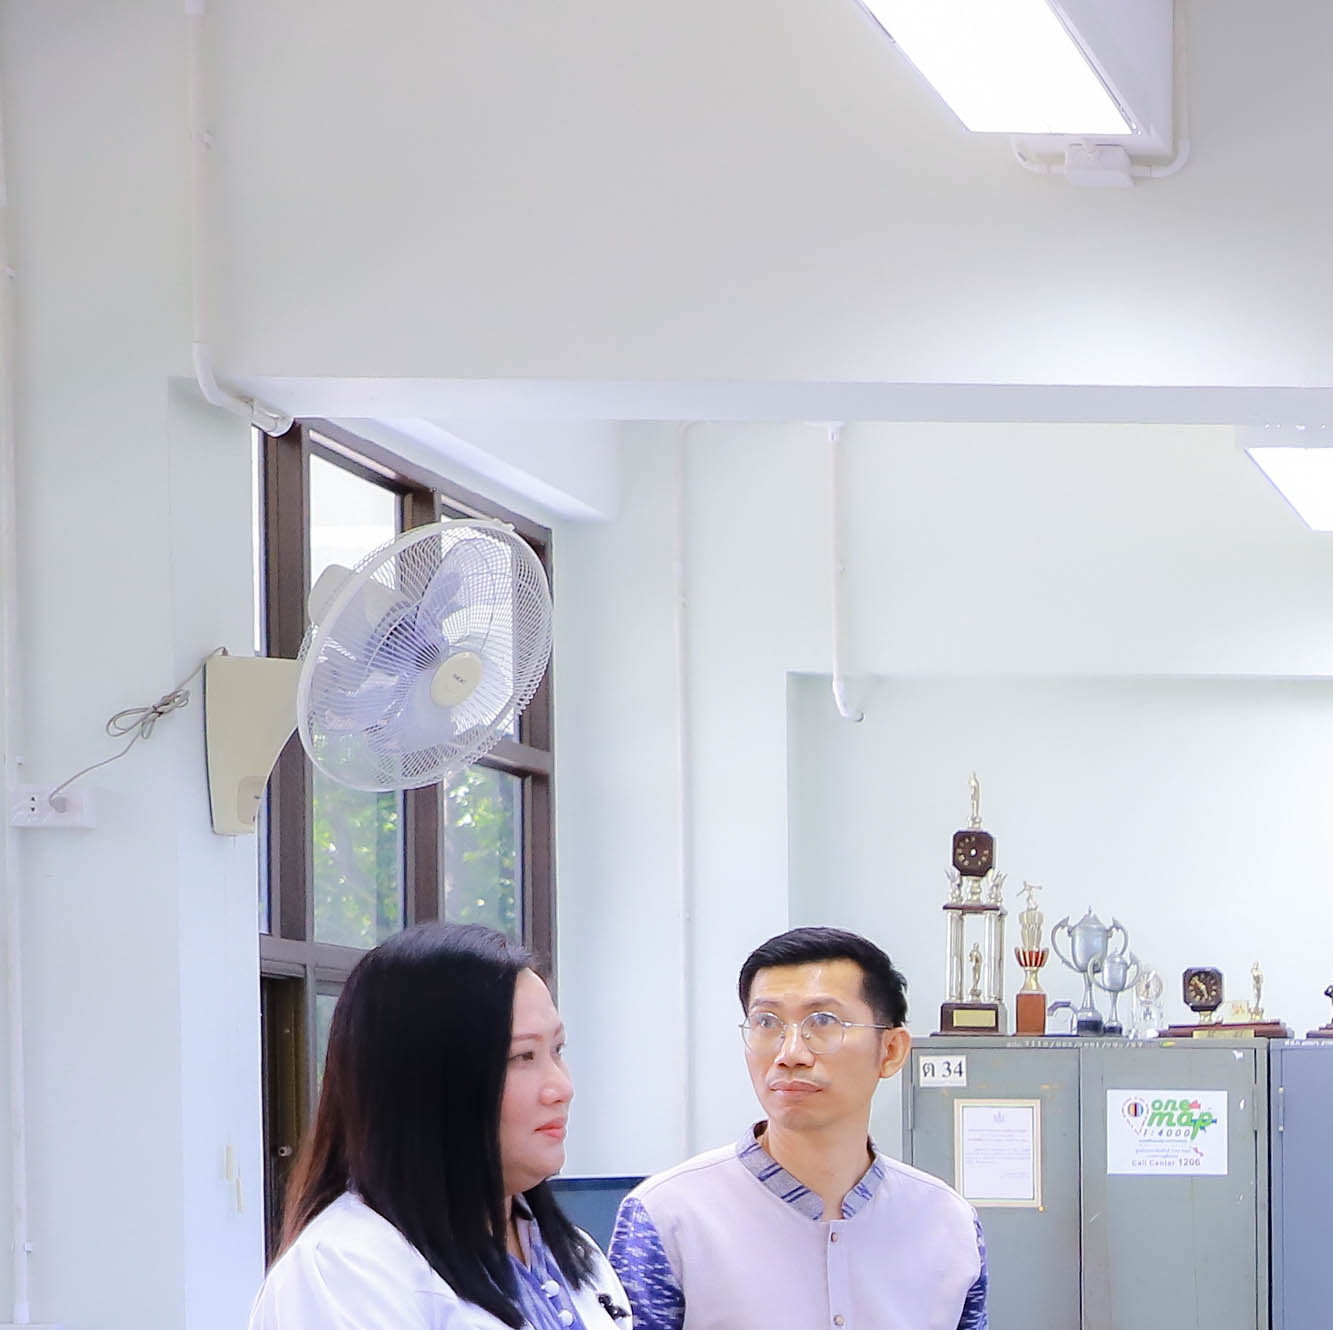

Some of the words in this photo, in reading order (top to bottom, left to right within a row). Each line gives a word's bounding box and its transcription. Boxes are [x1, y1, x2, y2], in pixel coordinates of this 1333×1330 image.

[942, 1060, 963, 1078] 34
[1151, 1099, 1192, 1111] one
[1146, 1110, 1214, 1140] map
